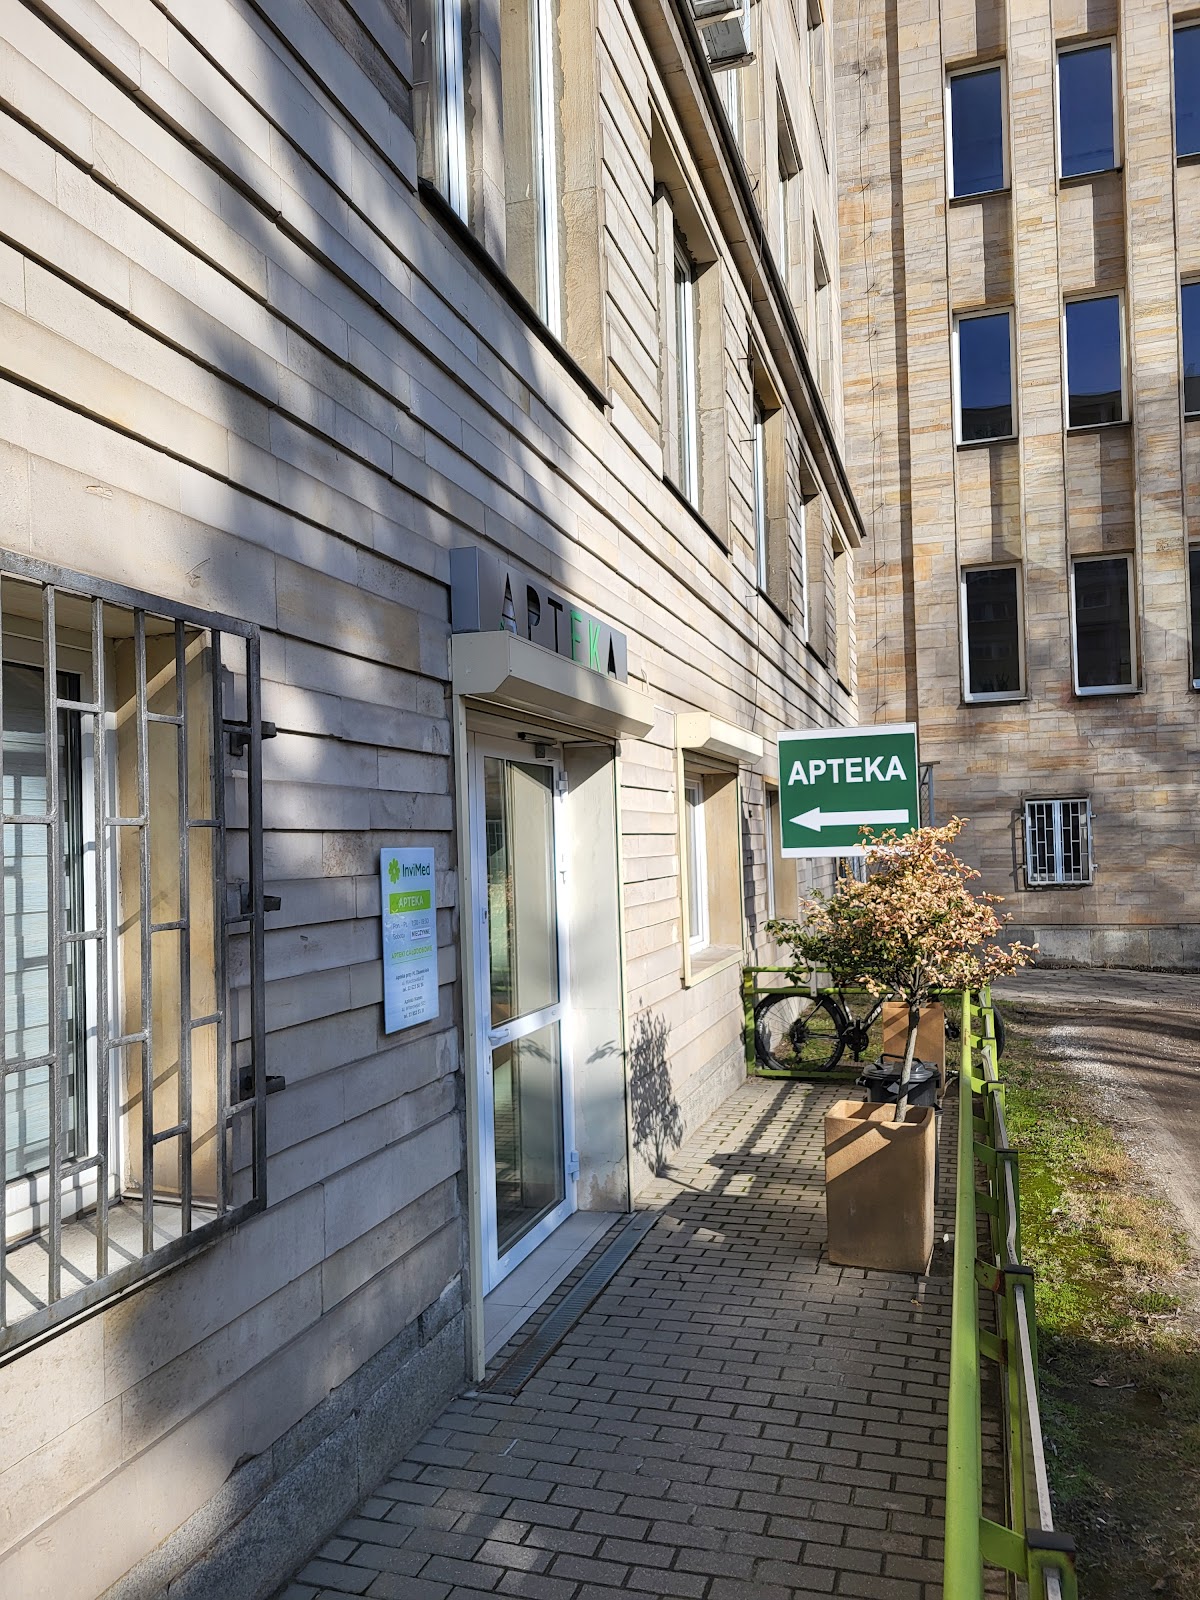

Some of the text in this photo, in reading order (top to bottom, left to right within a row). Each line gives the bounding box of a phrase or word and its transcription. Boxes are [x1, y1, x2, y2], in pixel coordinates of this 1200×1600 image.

[500, 572, 617, 680] APTEKA
[787, 755, 907, 786] APTEKA
[402, 863, 431, 877] InviMed
[398, 895, 424, 908] APTEKA
